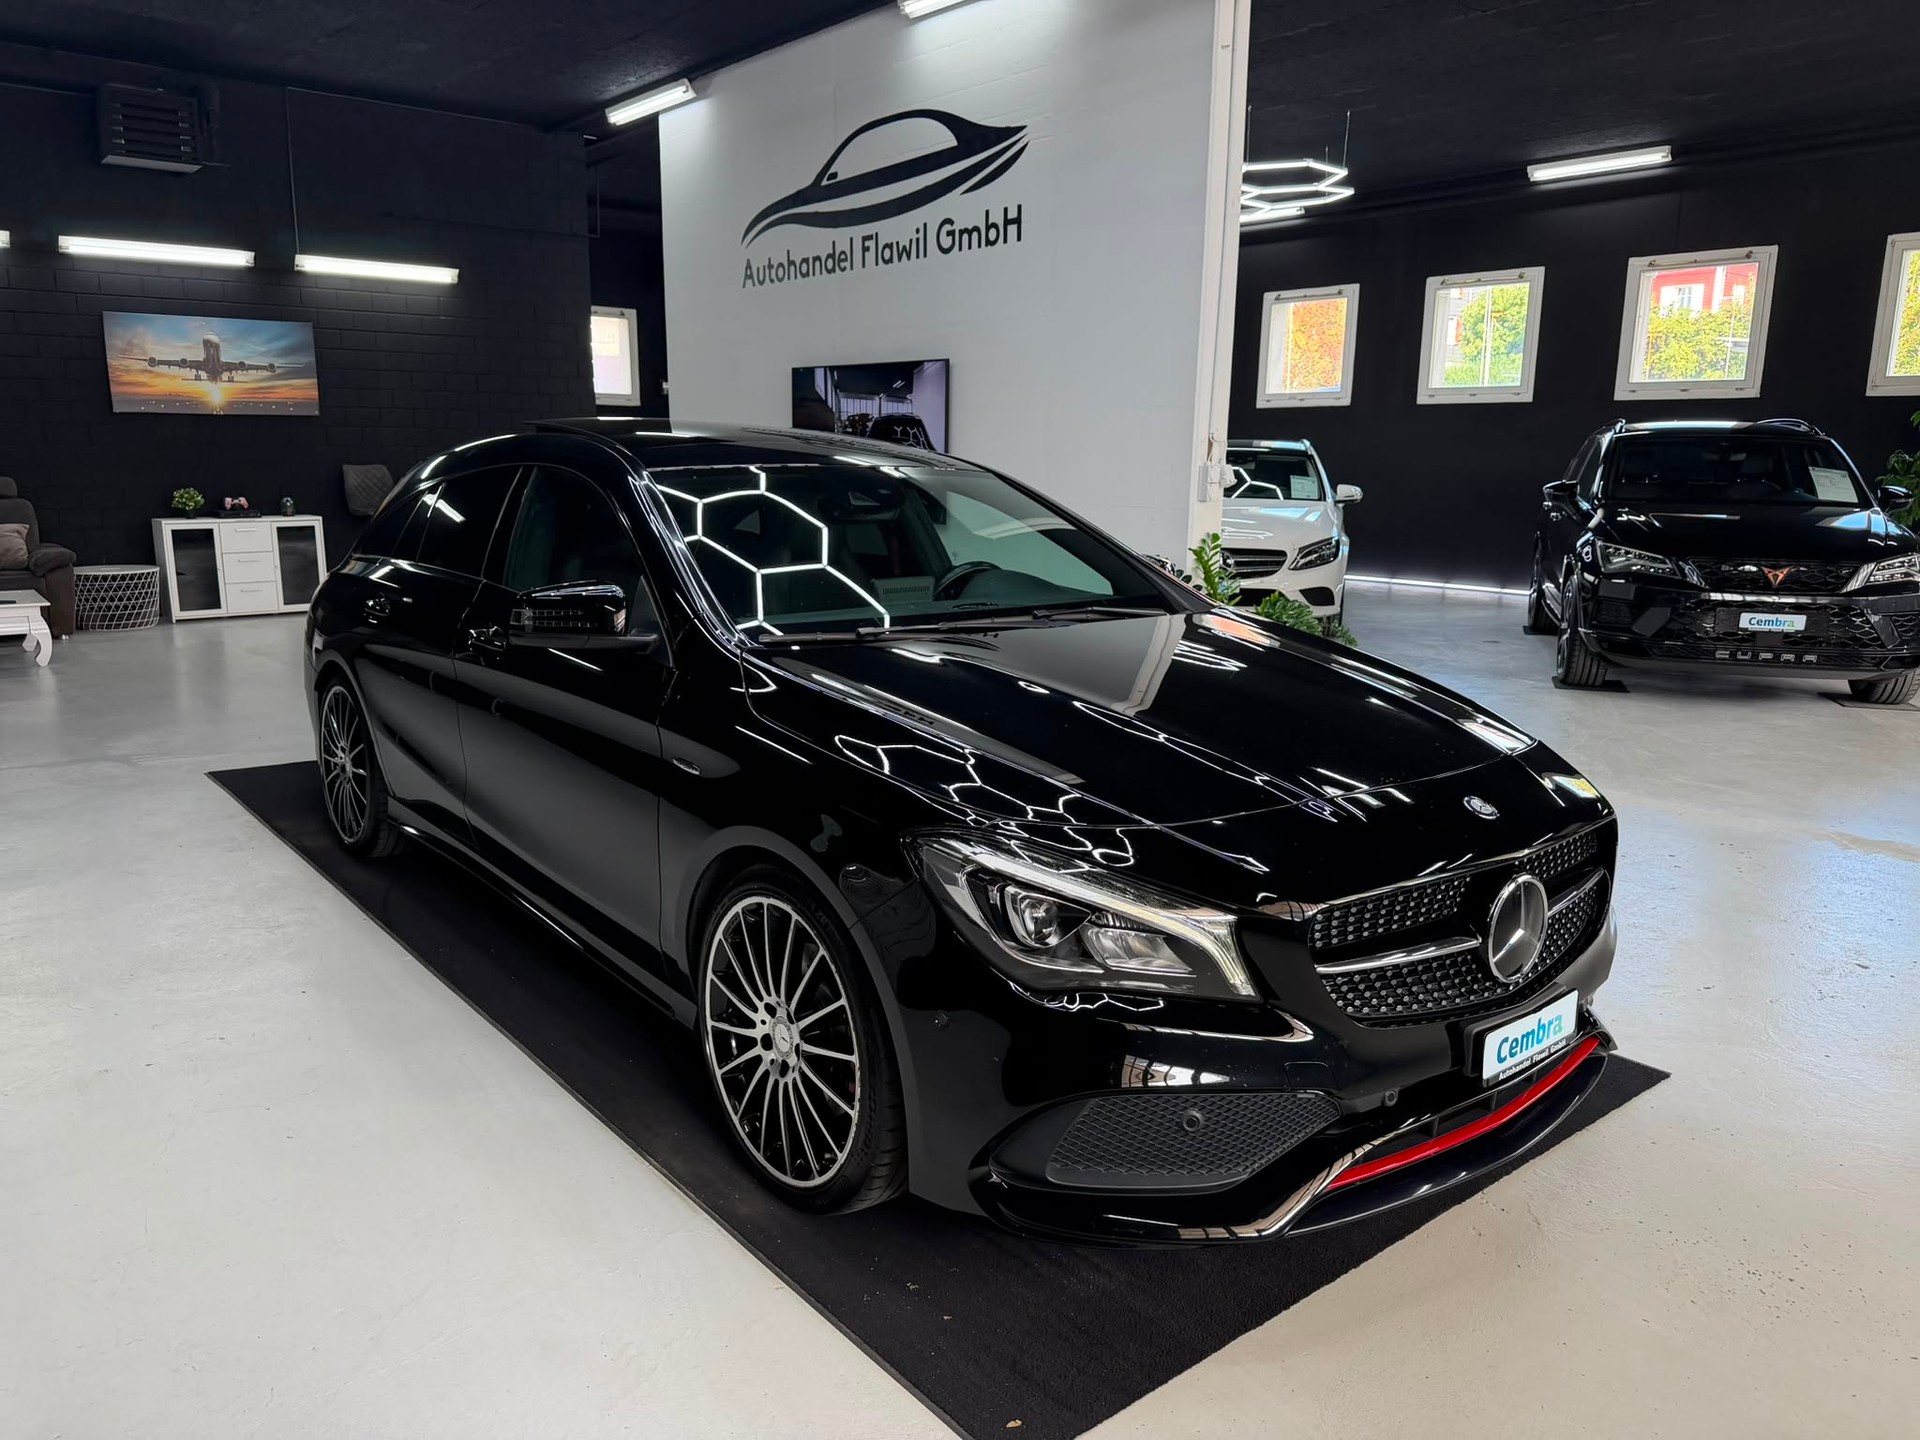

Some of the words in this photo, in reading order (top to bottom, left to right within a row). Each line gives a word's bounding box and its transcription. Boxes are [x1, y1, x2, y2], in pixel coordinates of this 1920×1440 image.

[742, 237, 854, 288] Autohandel
[861, 223, 928, 268] Flawil
[936, 204, 1022, 255] GmbH
[1748, 616, 1795, 628] Cembra
[1715, 650, 1818, 663] CUPRA
[1496, 1013, 1563, 1064] Cembra
[1498, 1058, 1531, 1081] Autohandel
[1533, 1047, 1549, 1064] Flawil
[1550, 1038, 1567, 1054] GmbH
